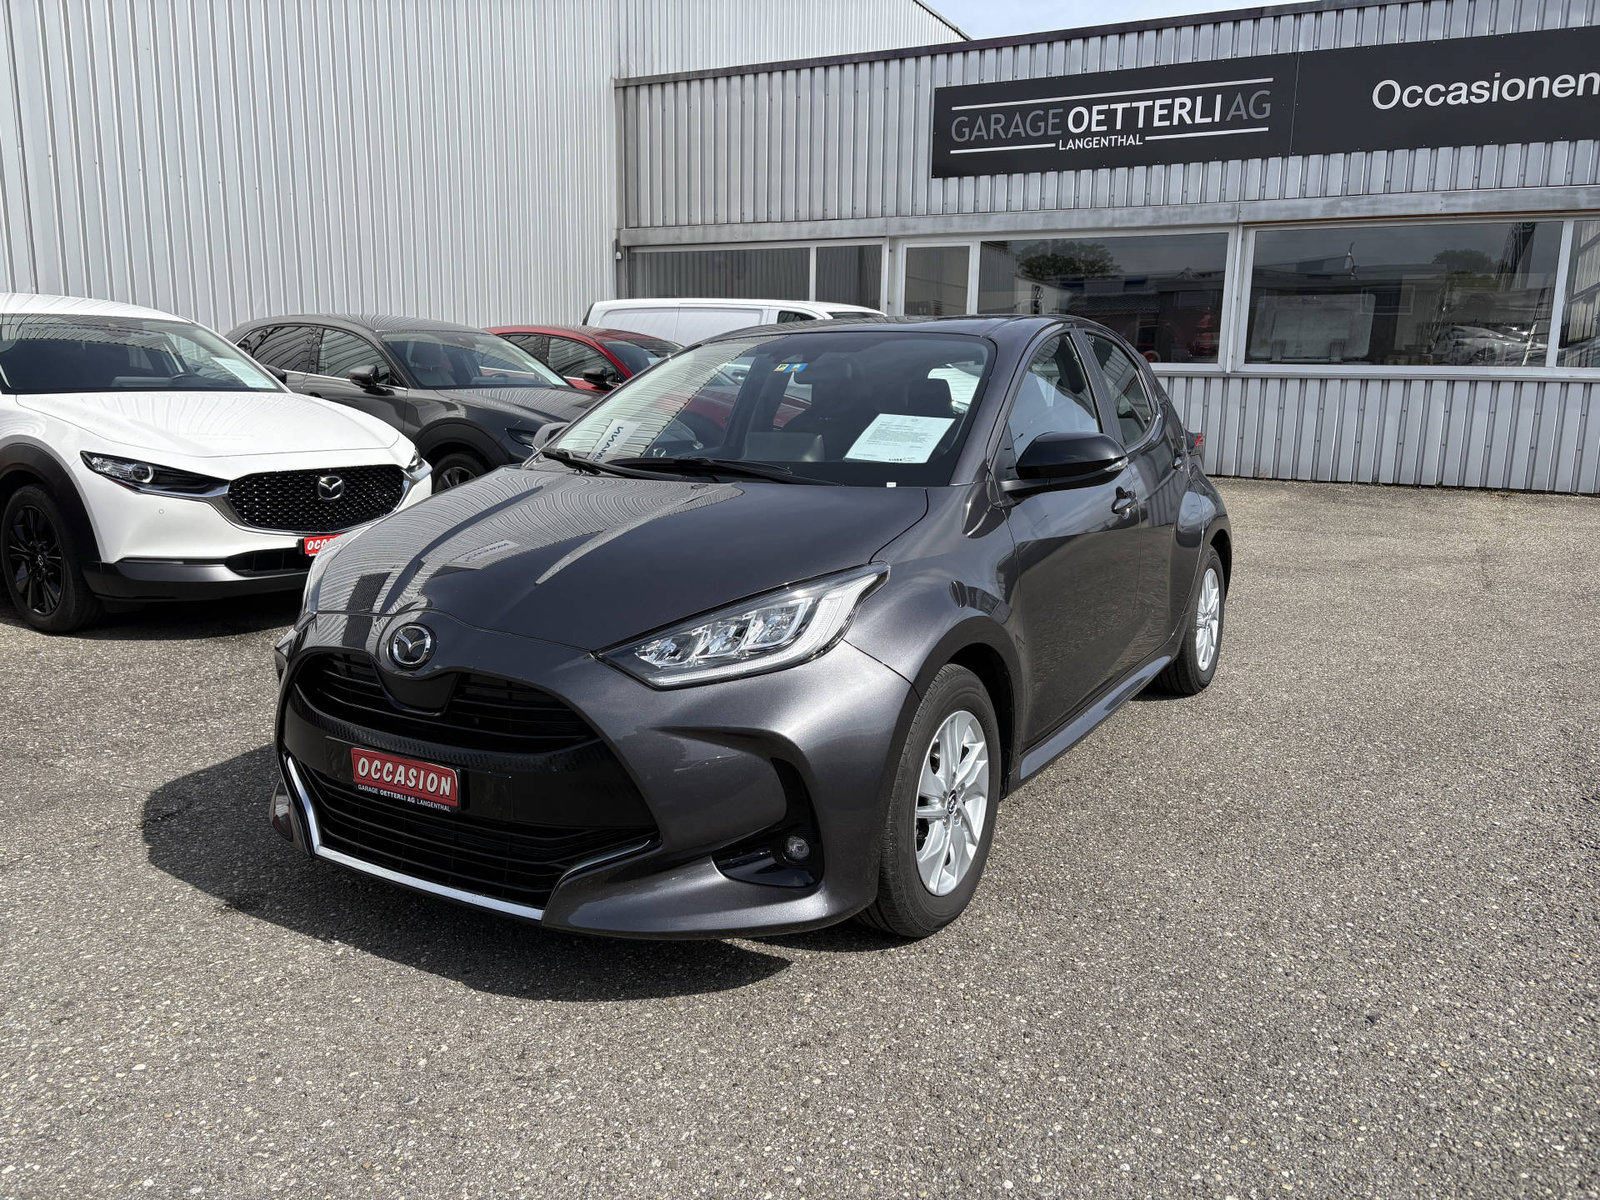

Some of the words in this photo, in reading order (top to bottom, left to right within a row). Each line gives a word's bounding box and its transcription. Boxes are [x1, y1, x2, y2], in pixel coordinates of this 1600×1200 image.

[1372, 71, 1600, 110] Occasionen
[951, 108, 1064, 143] GARAGE
[1067, 94, 1222, 134] OETTERLI
[1225, 89, 1272, 122] AG
[1058, 134, 1143, 151] LANGENTHAL
[357, 757, 452, 796] OCCASION
[357, 784, 379, 795] GARAGE
[379, 789, 406, 801] OETTERLI
[407, 796, 416, 804] AG
[416, 799, 451, 812] LANGENTHAL
